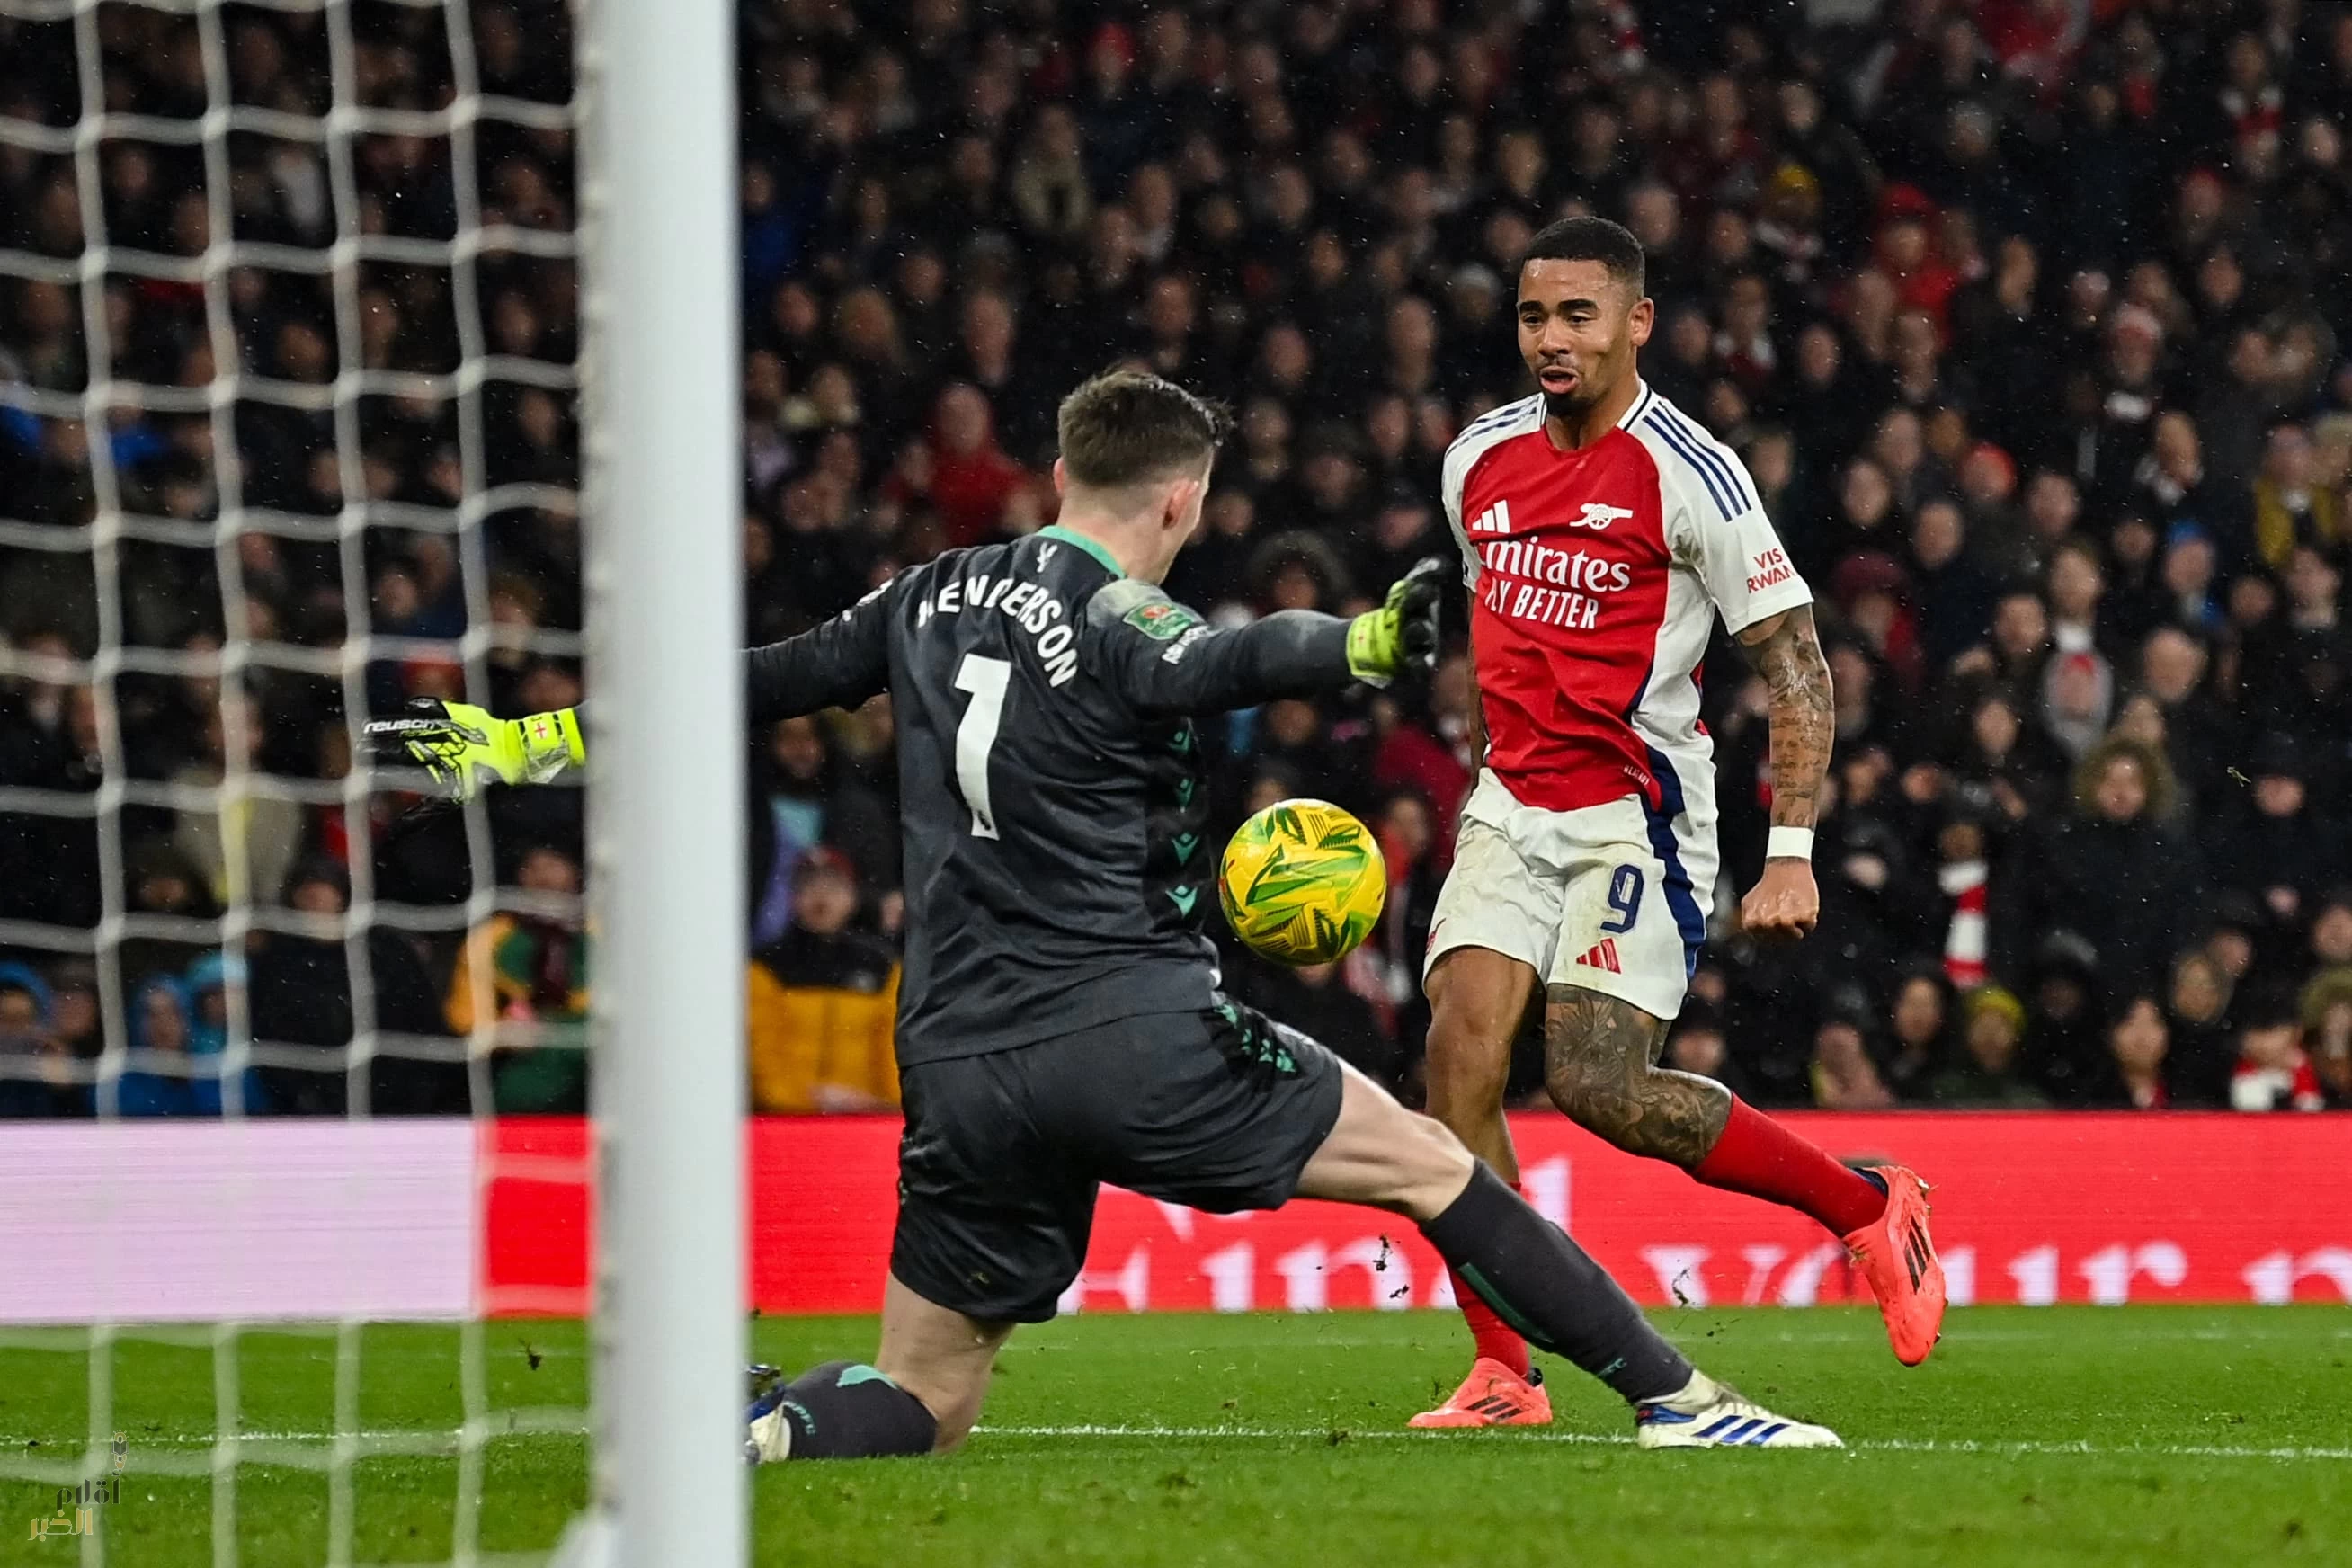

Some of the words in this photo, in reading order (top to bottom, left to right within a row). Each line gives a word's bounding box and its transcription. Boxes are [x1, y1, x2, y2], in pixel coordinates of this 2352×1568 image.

[1485, 535, 1631, 592] mirates
[1511, 584, 1599, 630] BETTER
[363, 718, 436, 735] reusch
[954, 652, 1012, 842] 1
[1599, 862, 1645, 934] 9
